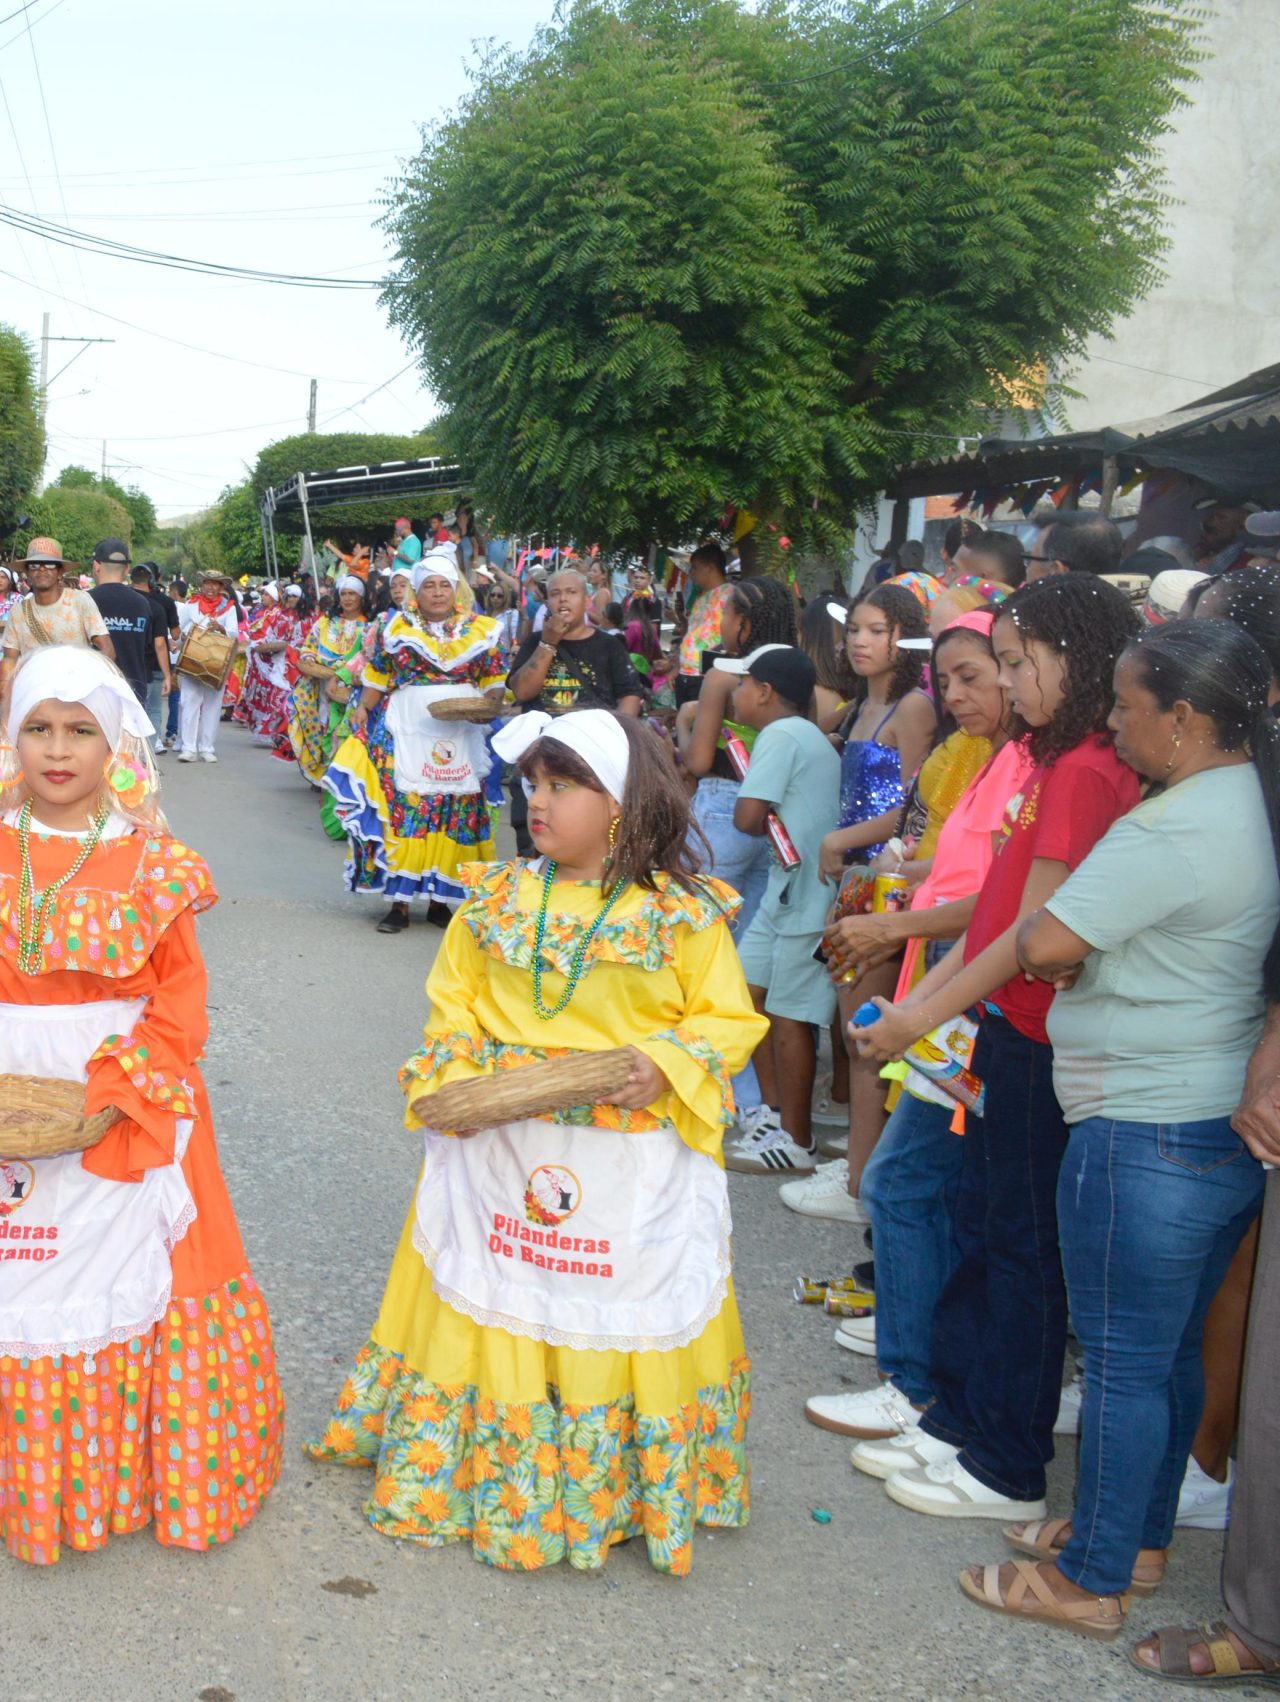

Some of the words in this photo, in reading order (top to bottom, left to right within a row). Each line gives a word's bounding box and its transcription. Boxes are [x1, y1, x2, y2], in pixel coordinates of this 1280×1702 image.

[103, 616, 133, 627] ANAL
[494, 1213, 610, 1254] Pilanderas
[489, 1234, 513, 1258] De
[520, 1245, 613, 1278] Baranoa
